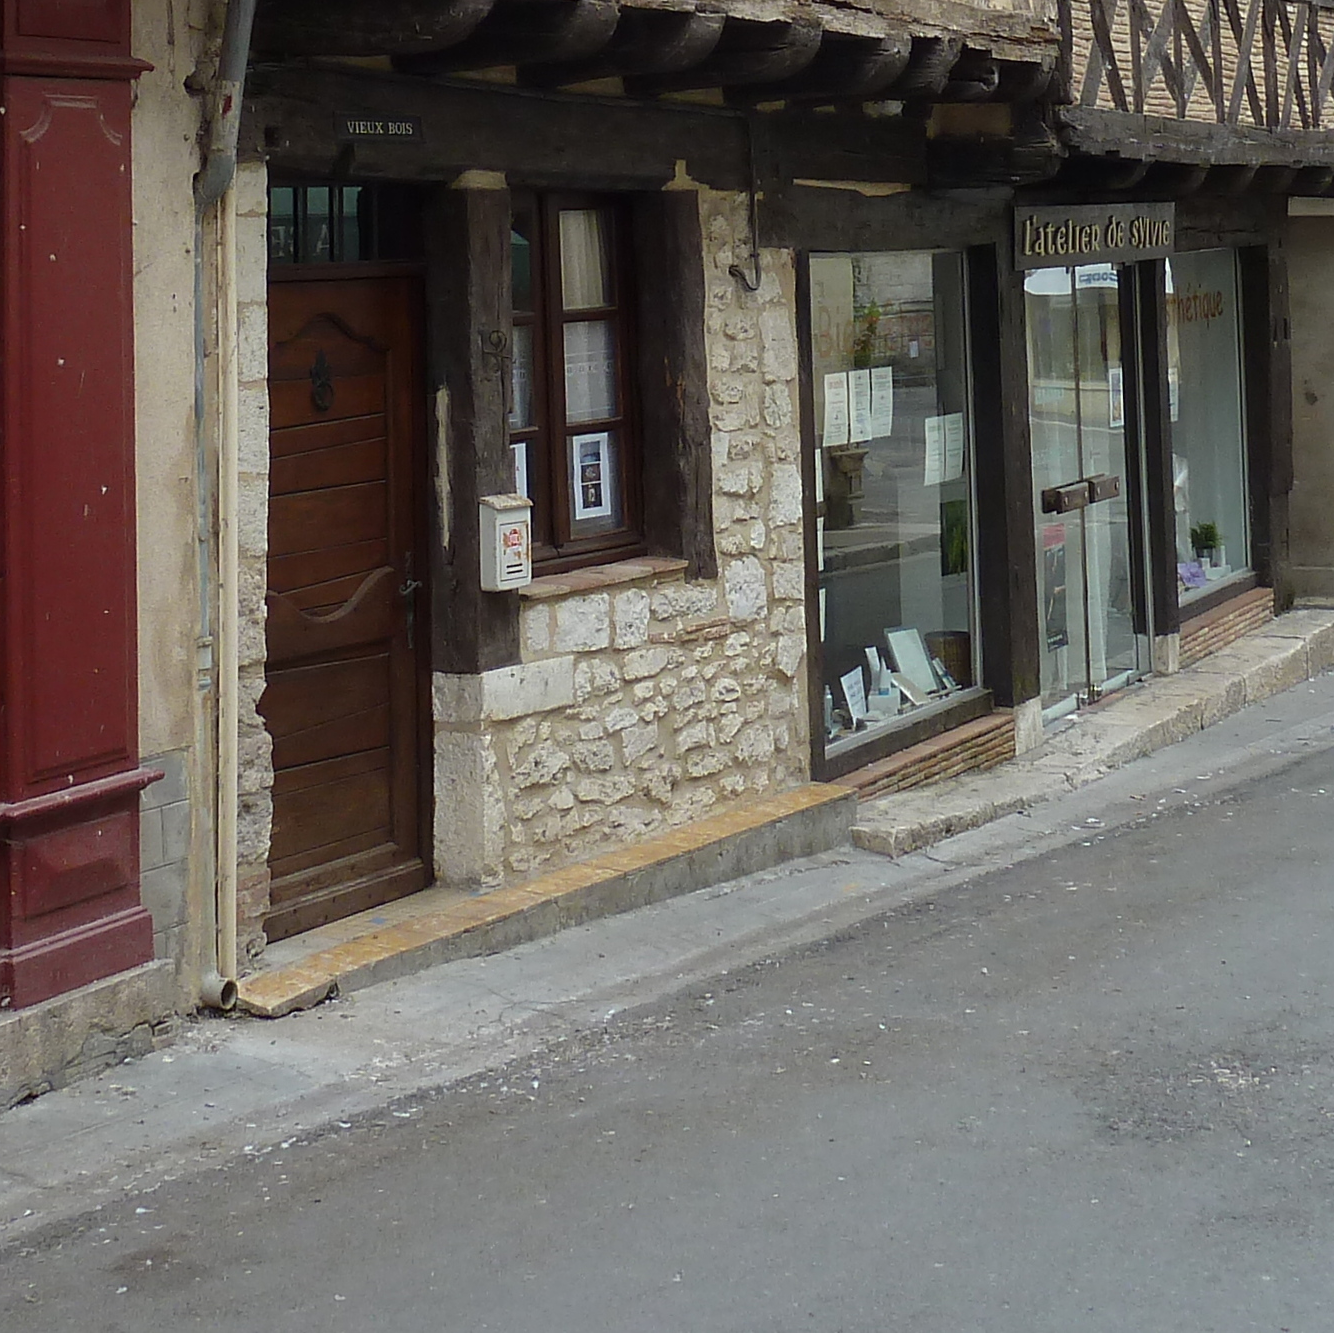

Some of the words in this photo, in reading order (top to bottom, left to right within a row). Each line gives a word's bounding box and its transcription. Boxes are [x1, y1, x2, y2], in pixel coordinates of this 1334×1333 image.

[347, 121, 384, 135] VIEUX
[388, 122, 413, 135] BOIS
[1106, 215, 1125, 249] de
